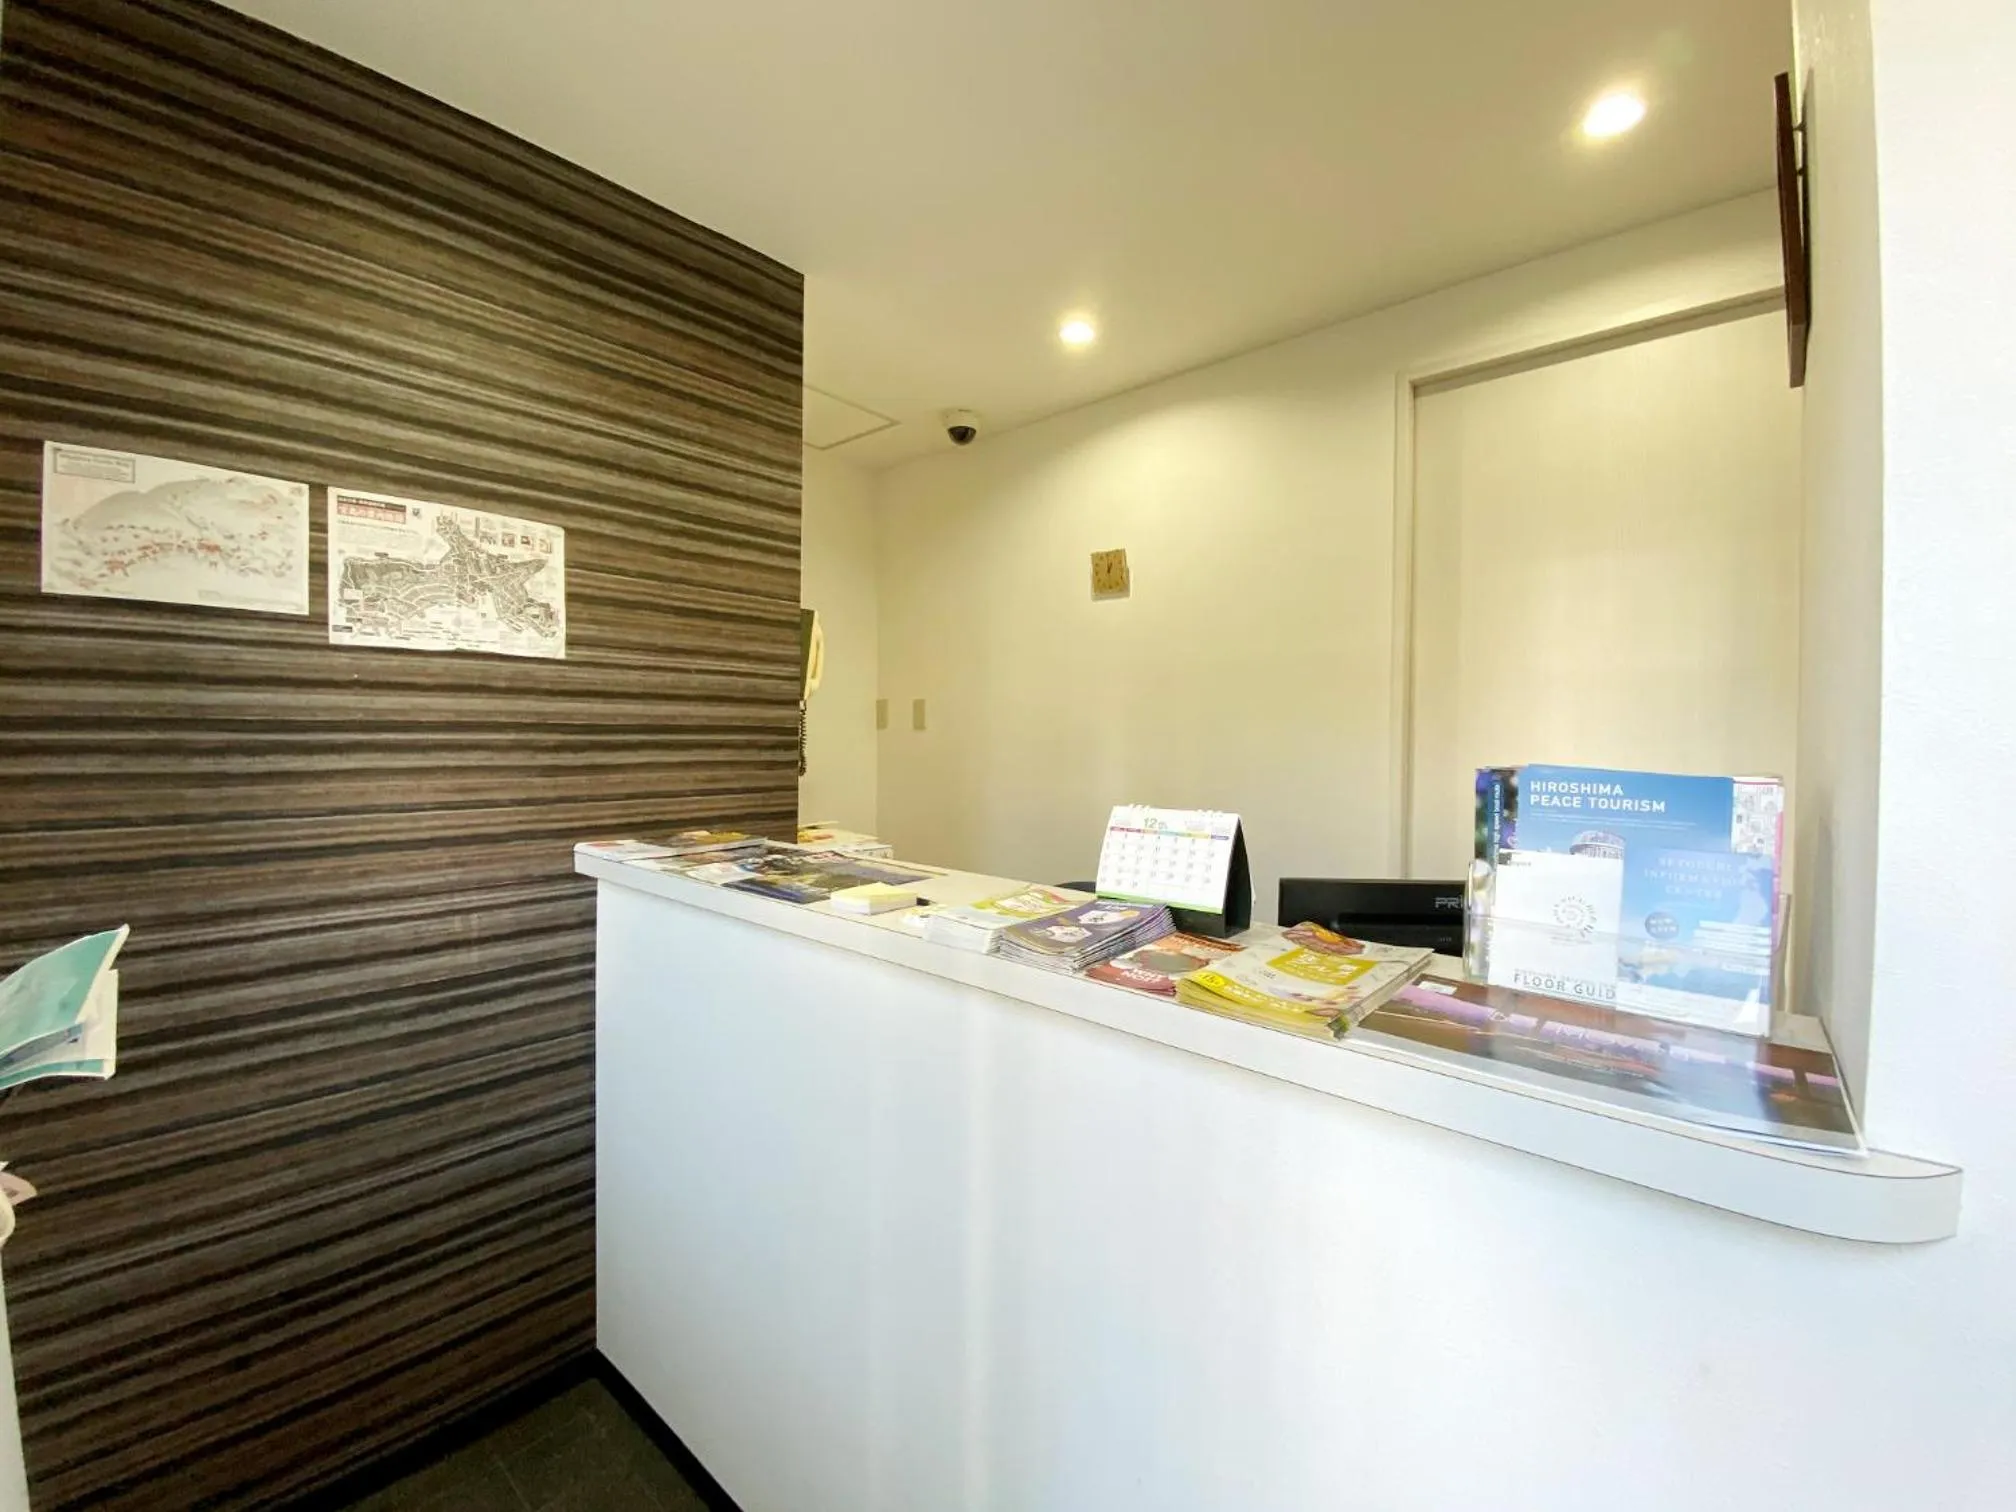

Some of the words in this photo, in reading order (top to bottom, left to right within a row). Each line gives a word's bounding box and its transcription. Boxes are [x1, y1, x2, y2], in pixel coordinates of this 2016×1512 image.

[1530, 780, 1624, 796] HIROSHIMA
[1530, 794, 1582, 808] PEACE
[1587, 797, 1666, 813] TOURISM
[1513, 973, 1566, 992] FLOOR
